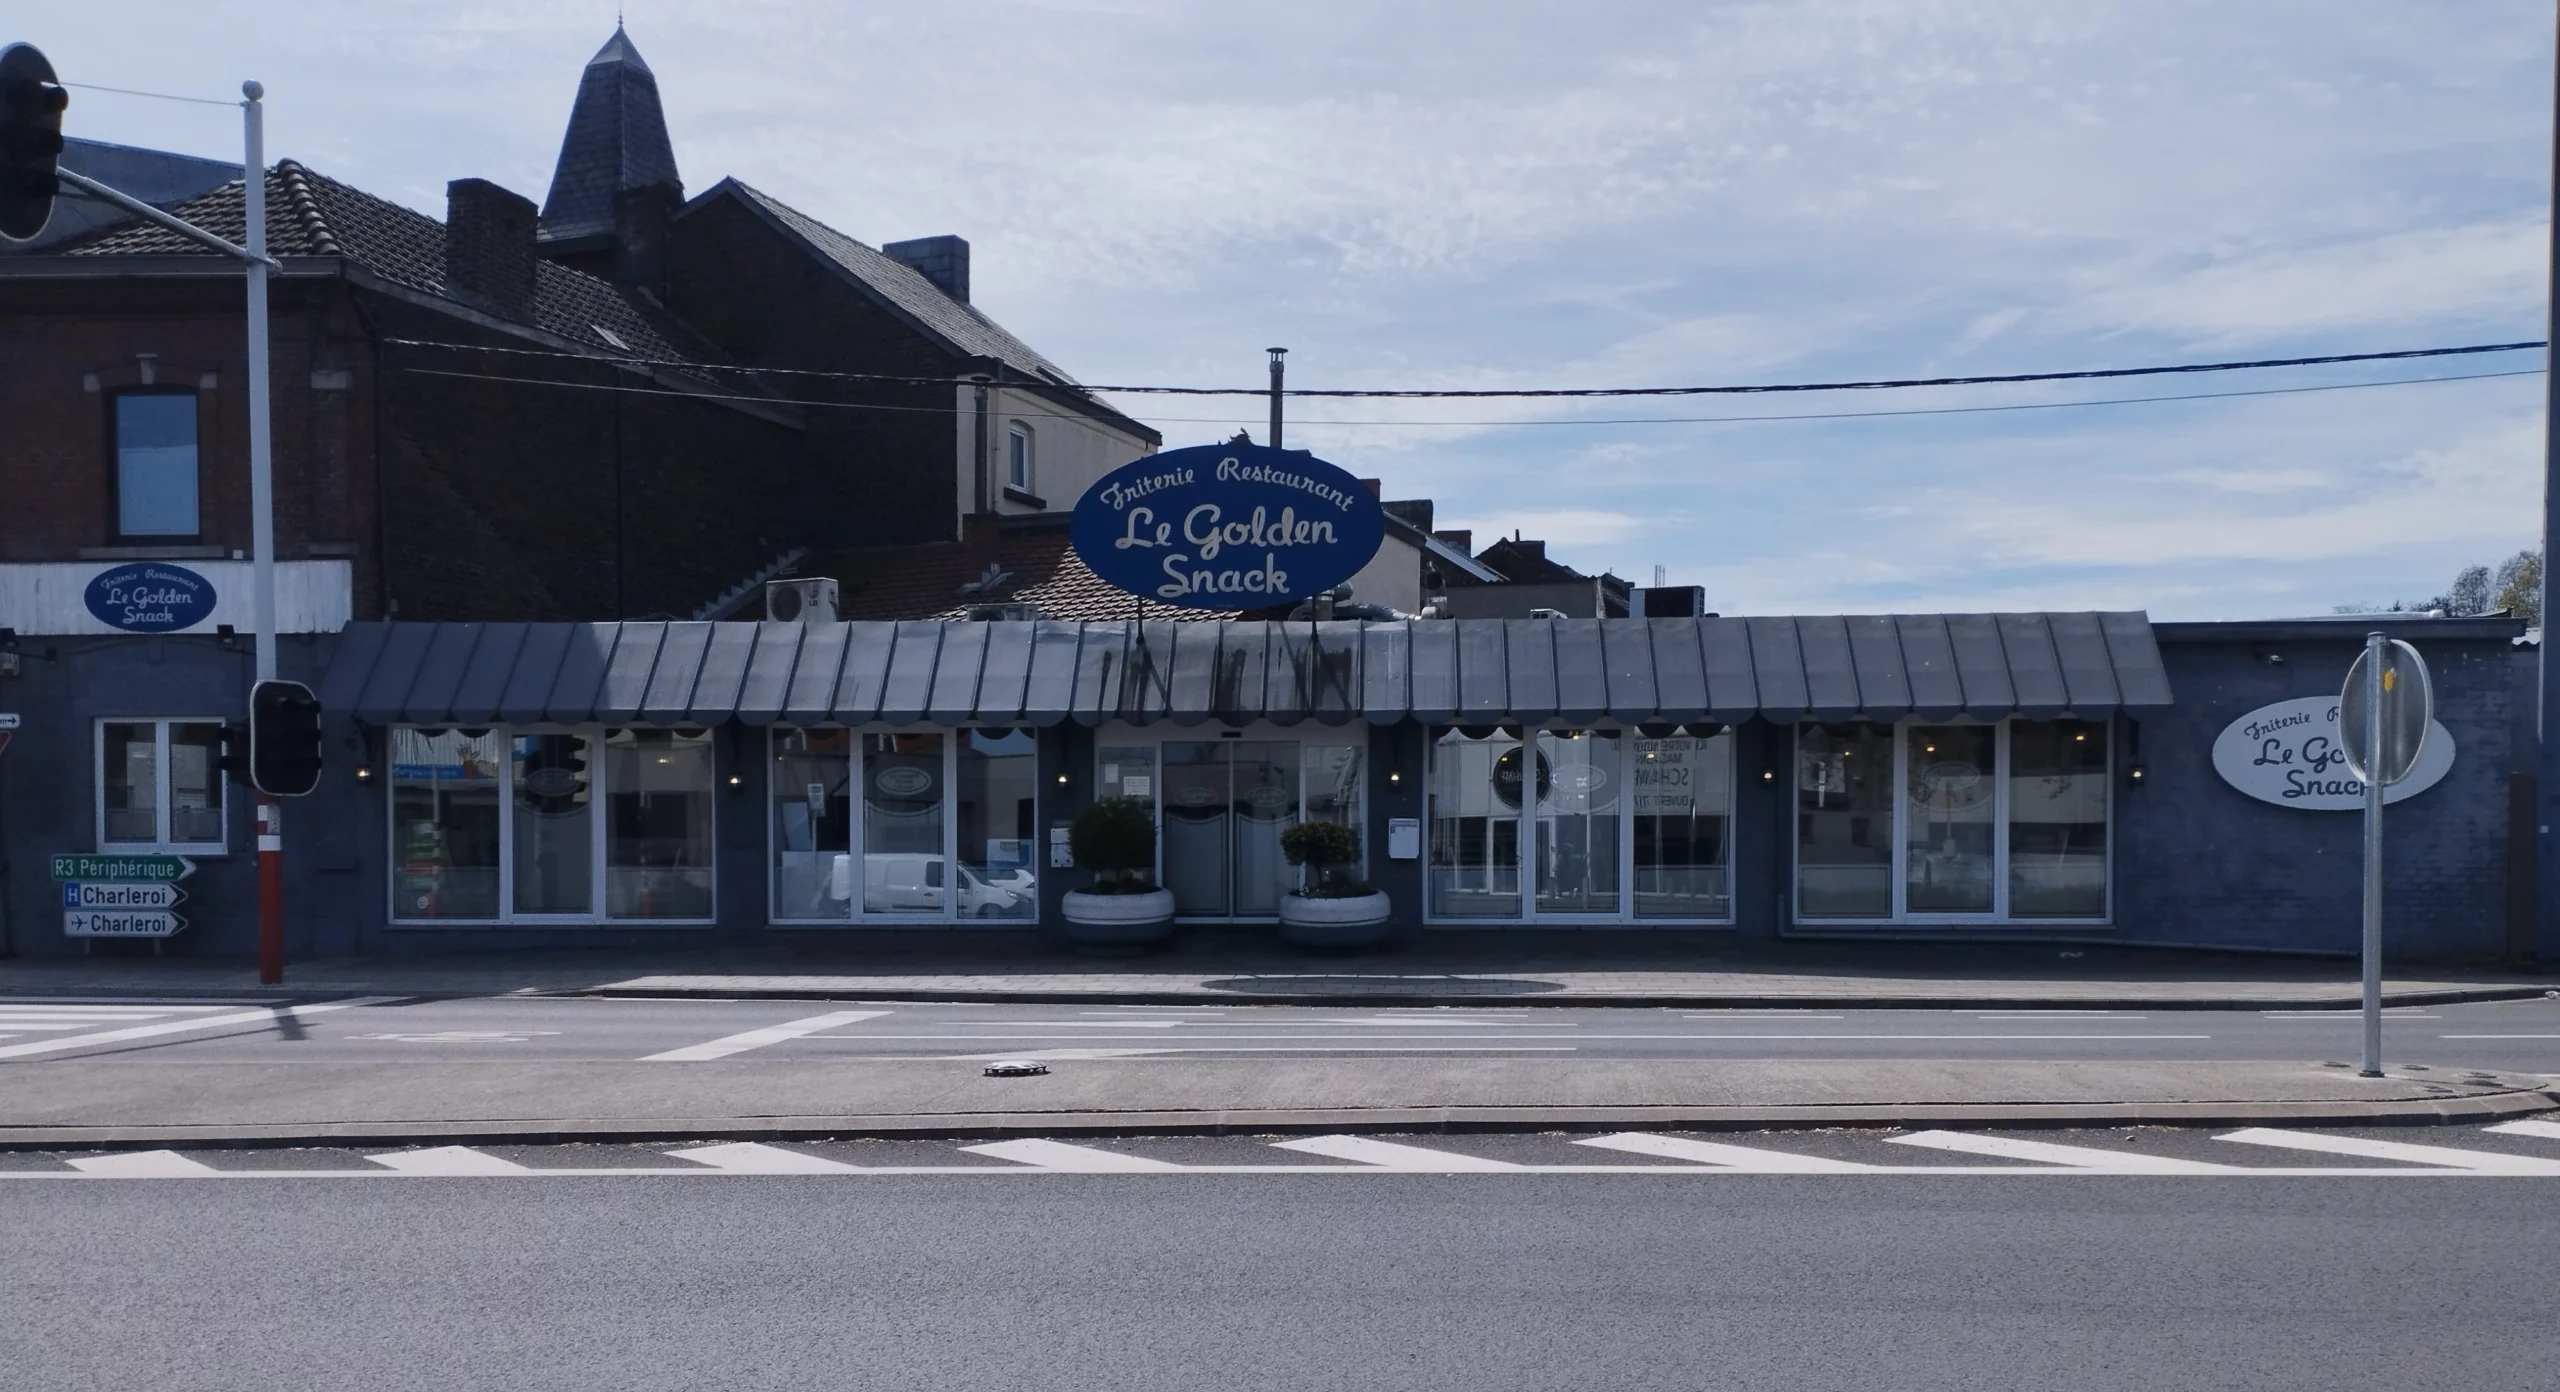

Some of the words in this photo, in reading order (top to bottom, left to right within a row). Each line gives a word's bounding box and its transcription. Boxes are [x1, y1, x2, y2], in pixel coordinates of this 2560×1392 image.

[1100, 467, 1195, 511] Friterie
[1216, 457, 1354, 512] Restaurant
[1115, 507, 1172, 550] Le
[1183, 503, 1338, 560] Golden
[100, 572, 137, 590] Friterie
[145, 568, 199, 591] Restaurant
[1157, 553, 1290, 598] Snack
[106, 588, 129, 604] Le
[132, 586, 193, 608] Golden
[122, 606, 175, 623] Snack
[2244, 712, 2310, 739] Friterie
[2253, 738, 2294, 766] Le
[55, 860, 74, 877] R3
[80, 859, 175, 881] Périphérique
[83, 886, 166, 905] Charleroi
[90, 913, 166, 933] Charleroi
